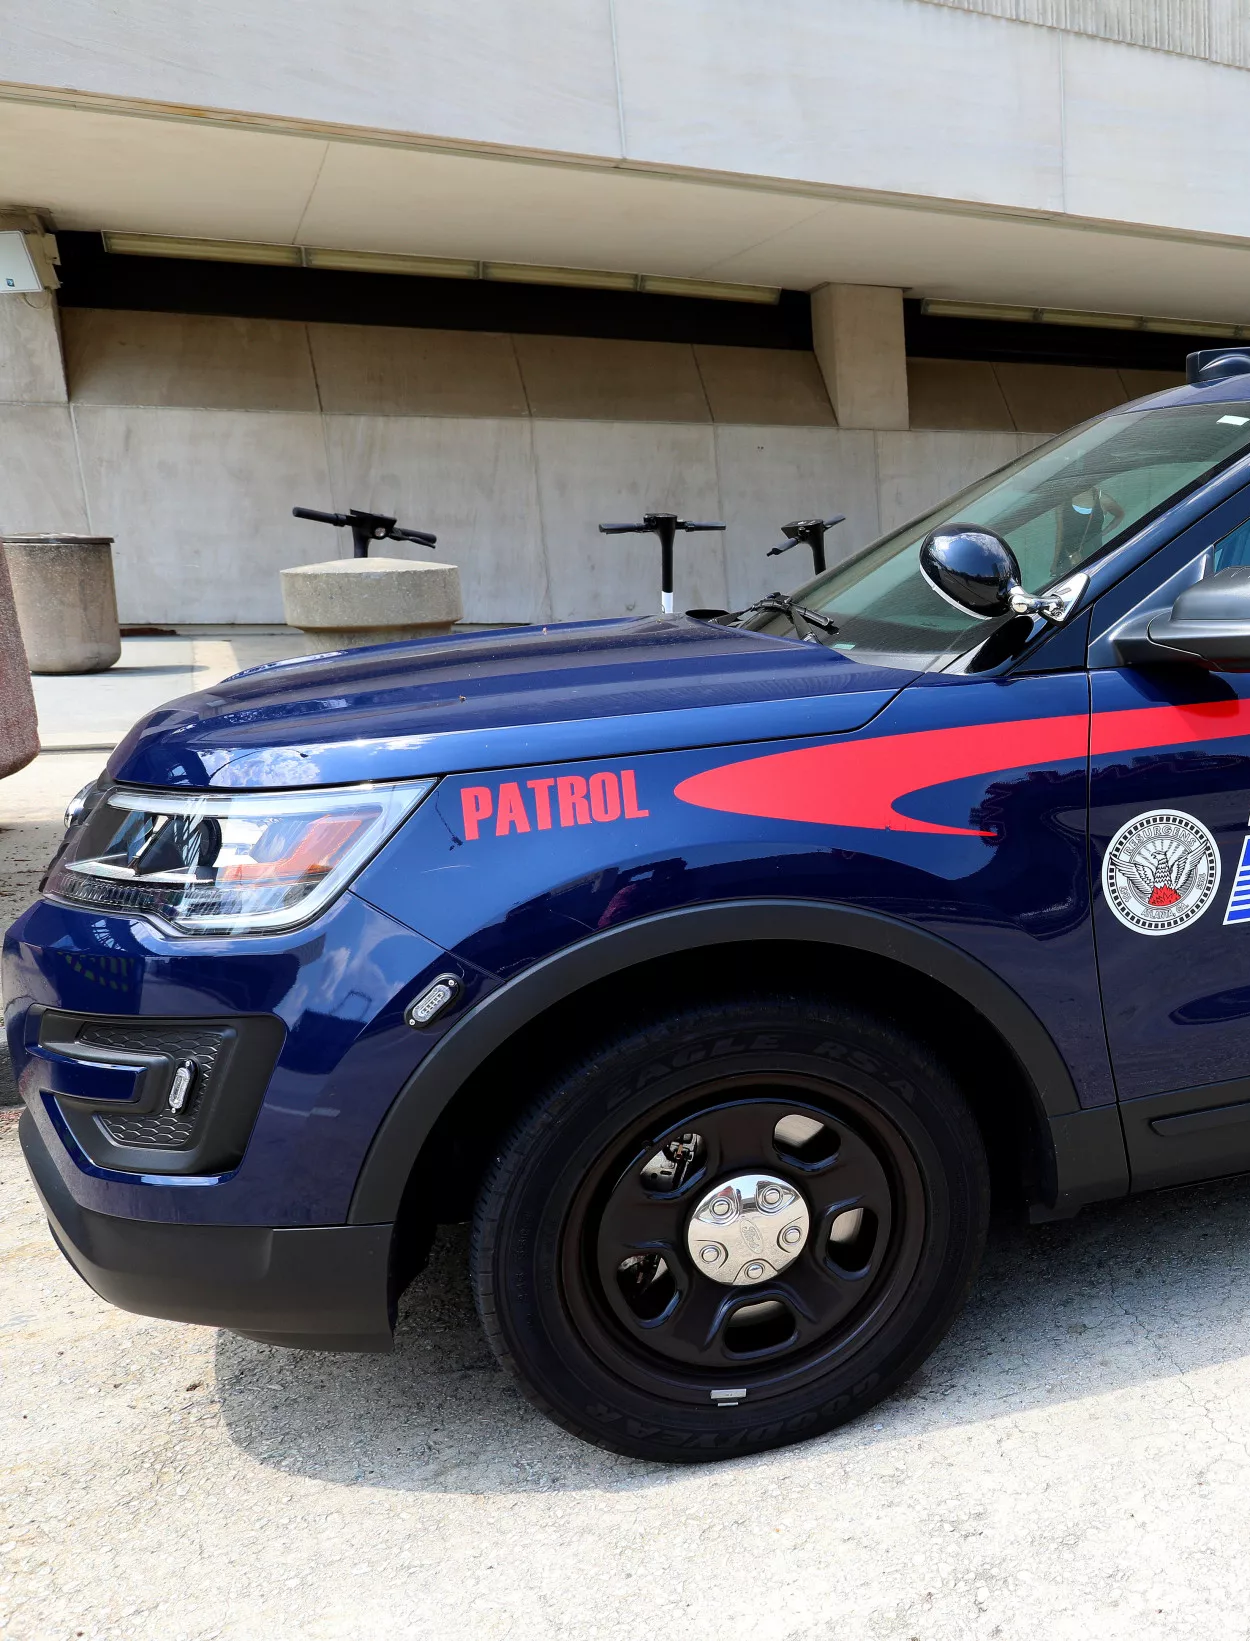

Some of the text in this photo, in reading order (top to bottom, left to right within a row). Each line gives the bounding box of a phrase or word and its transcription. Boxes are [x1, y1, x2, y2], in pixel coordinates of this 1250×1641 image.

[460, 769, 650, 841] PATROL
[1123, 825, 1197, 856] RESURGENS
[606, 1032, 787, 1111] EAGLE
[585, 1371, 884, 1450] GOODYEAR
